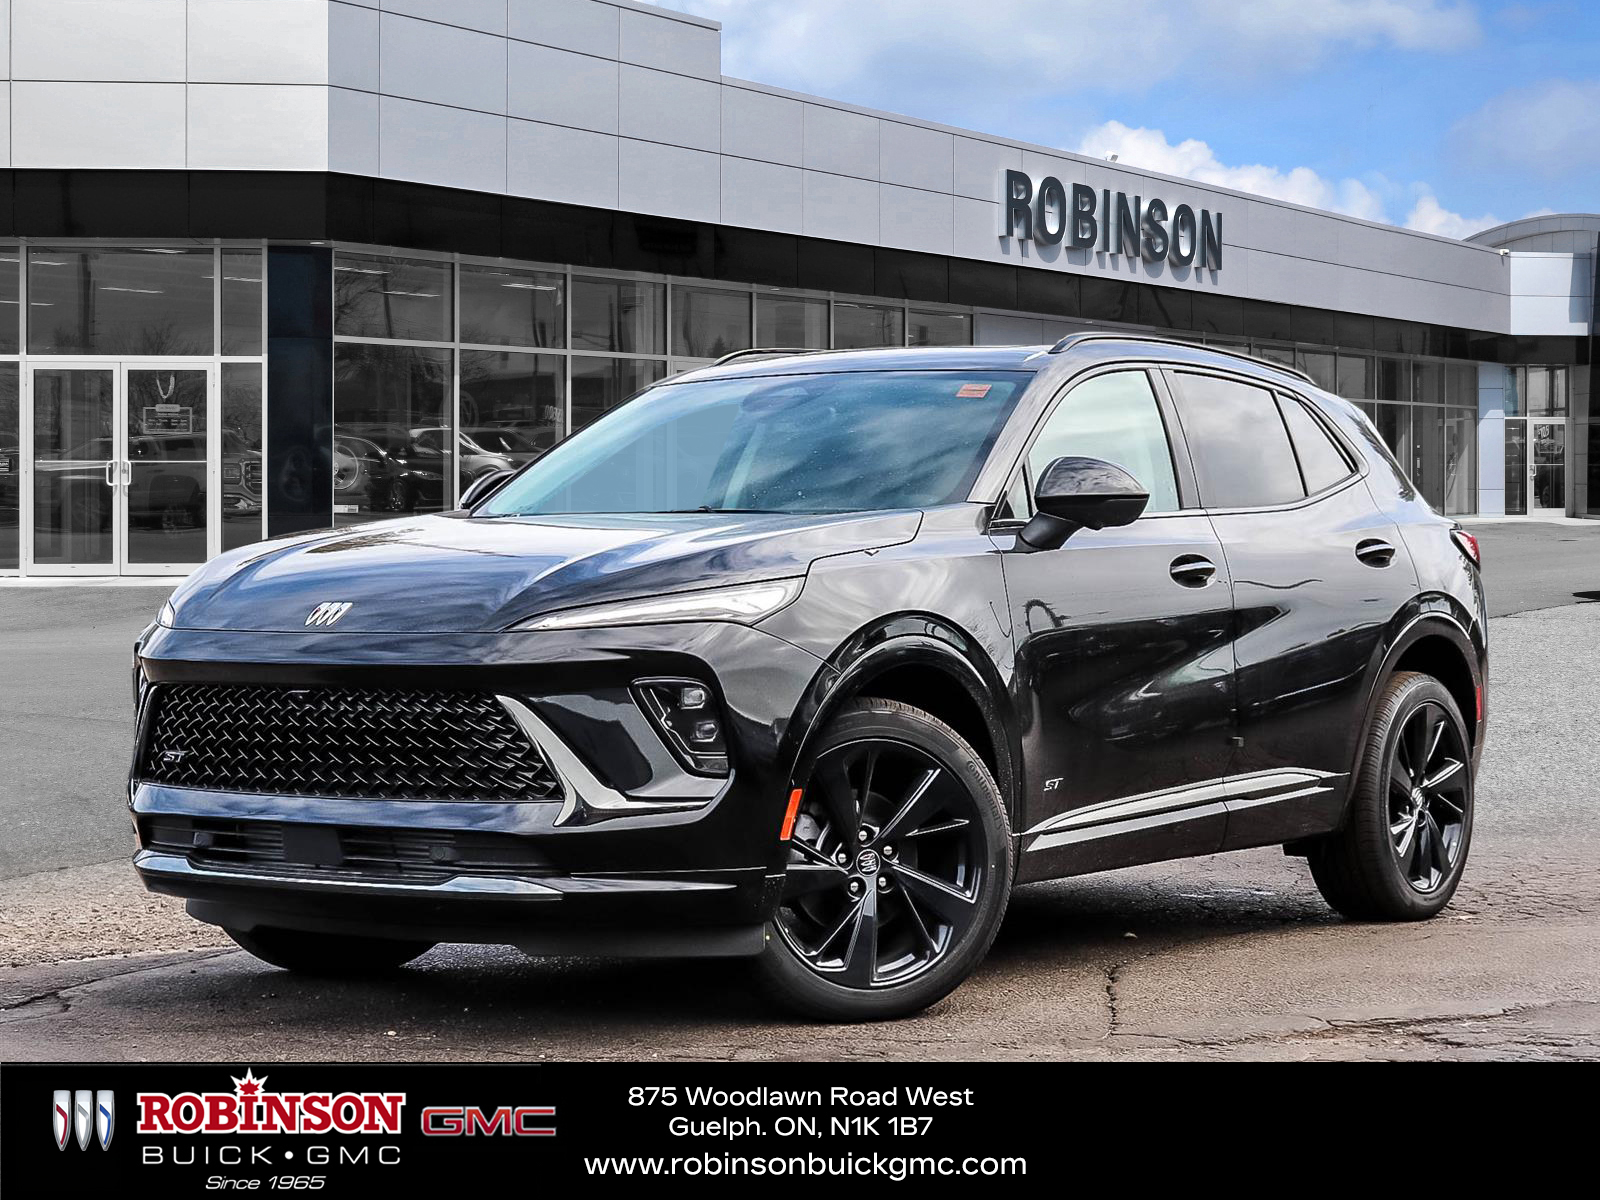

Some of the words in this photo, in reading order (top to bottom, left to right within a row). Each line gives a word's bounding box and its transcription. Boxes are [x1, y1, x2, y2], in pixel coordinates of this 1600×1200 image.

[998, 168, 1223, 273] ROBINSON
[162, 750, 187, 763] ST
[1043, 777, 1065, 792] ST
